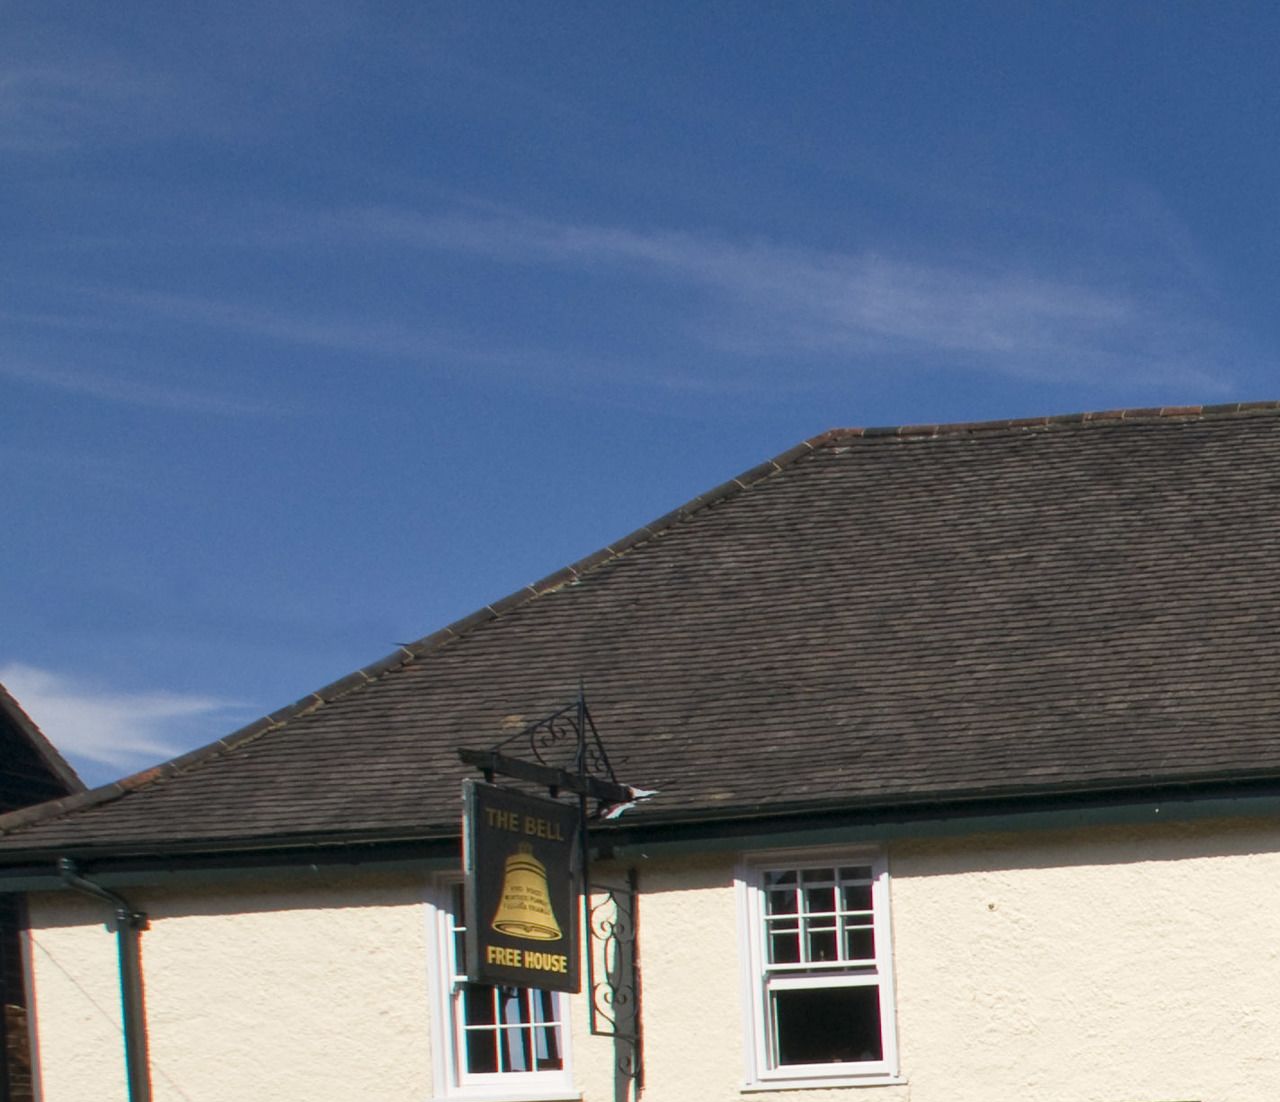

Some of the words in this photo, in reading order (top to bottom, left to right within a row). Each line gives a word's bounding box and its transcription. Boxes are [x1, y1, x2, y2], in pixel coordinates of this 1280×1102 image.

[486, 808, 519, 831] THE
[525, 815, 564, 841] BELL
[487, 946, 521, 968] FREE
[525, 951, 567, 973] HOUSE
